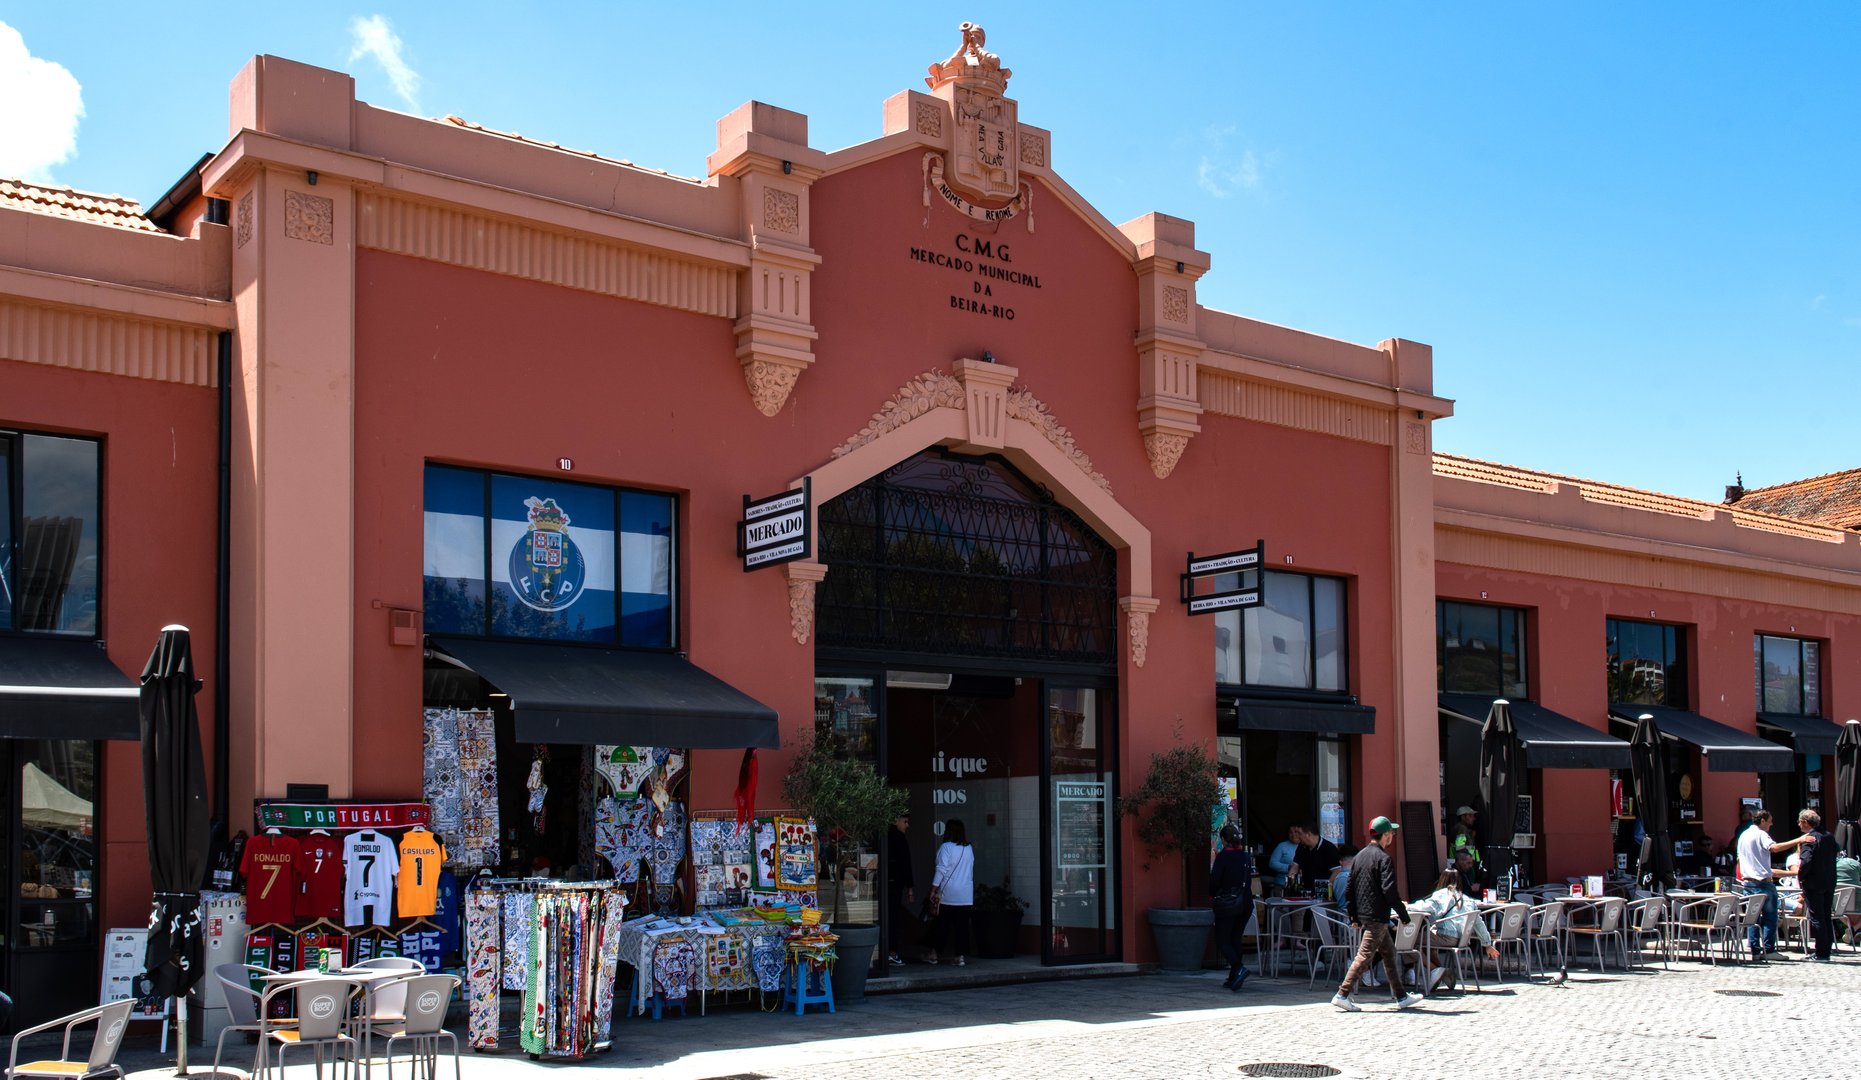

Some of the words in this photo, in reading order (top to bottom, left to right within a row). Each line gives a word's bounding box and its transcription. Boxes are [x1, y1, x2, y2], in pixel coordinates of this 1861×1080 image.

[940, 184, 963, 208] NOME
[968, 205, 974, 216] E
[910, 247, 973, 272] MERCADO
[979, 264, 1042, 288] MUNICIPAL
[974, 281, 992, 296] DA
[950, 296, 1015, 320] BEIRA-RIO
[559, 458, 571, 470] 10
[748, 516, 801, 543] MERCADO
[949, 757, 987, 778] que
[1062, 786, 1103, 796] MERCADO
[304, 810, 392, 823] PORTUGAL
[254, 854, 291, 862] RONALDO
[354, 845, 381, 853] RONALDO
[314, 858, 323, 873] 7
[358, 855, 375, 887] 7
[414, 856, 423, 887] 1
[260, 865, 281, 899] 7
